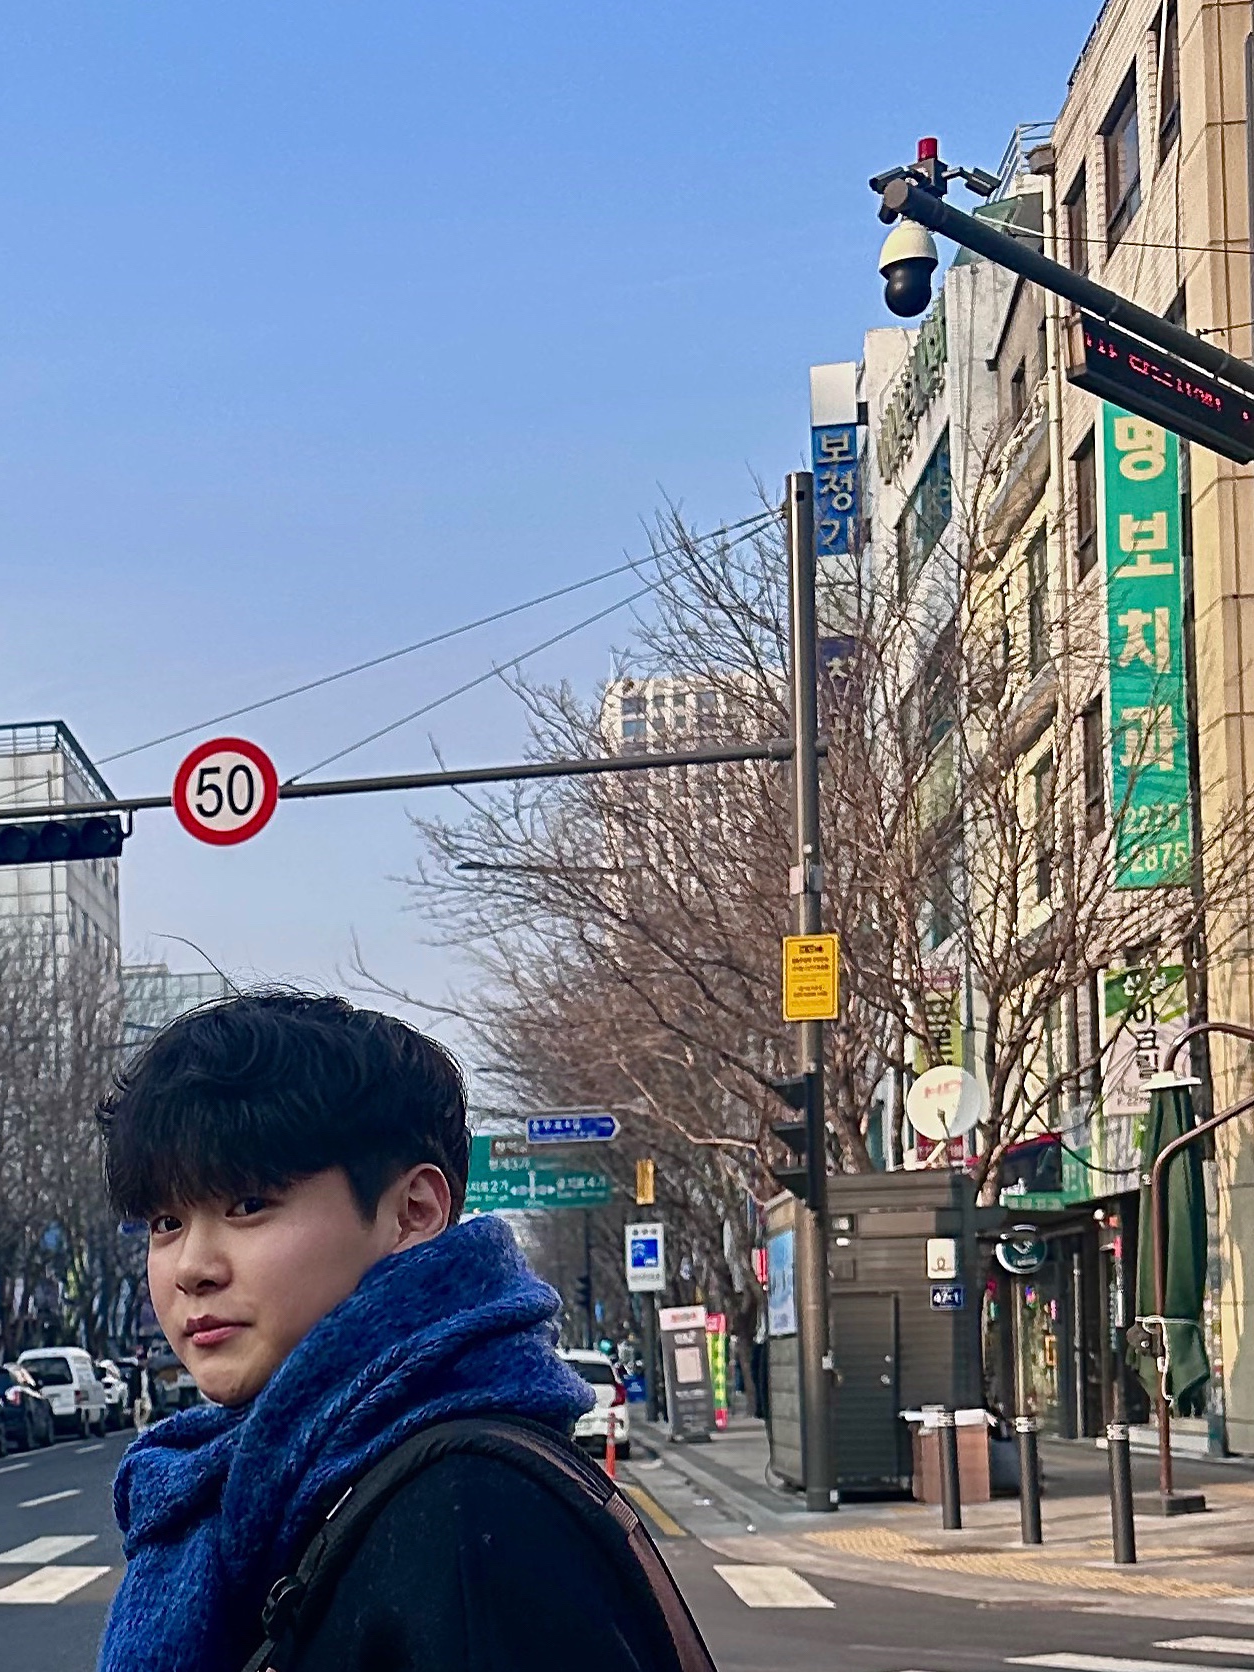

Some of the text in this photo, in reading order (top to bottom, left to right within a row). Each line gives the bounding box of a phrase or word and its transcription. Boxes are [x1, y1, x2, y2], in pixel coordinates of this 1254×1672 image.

[817, 431, 856, 547] 보청기
[1112, 415, 1175, 772] 명보치과
[195, 763, 255, 819] 50
